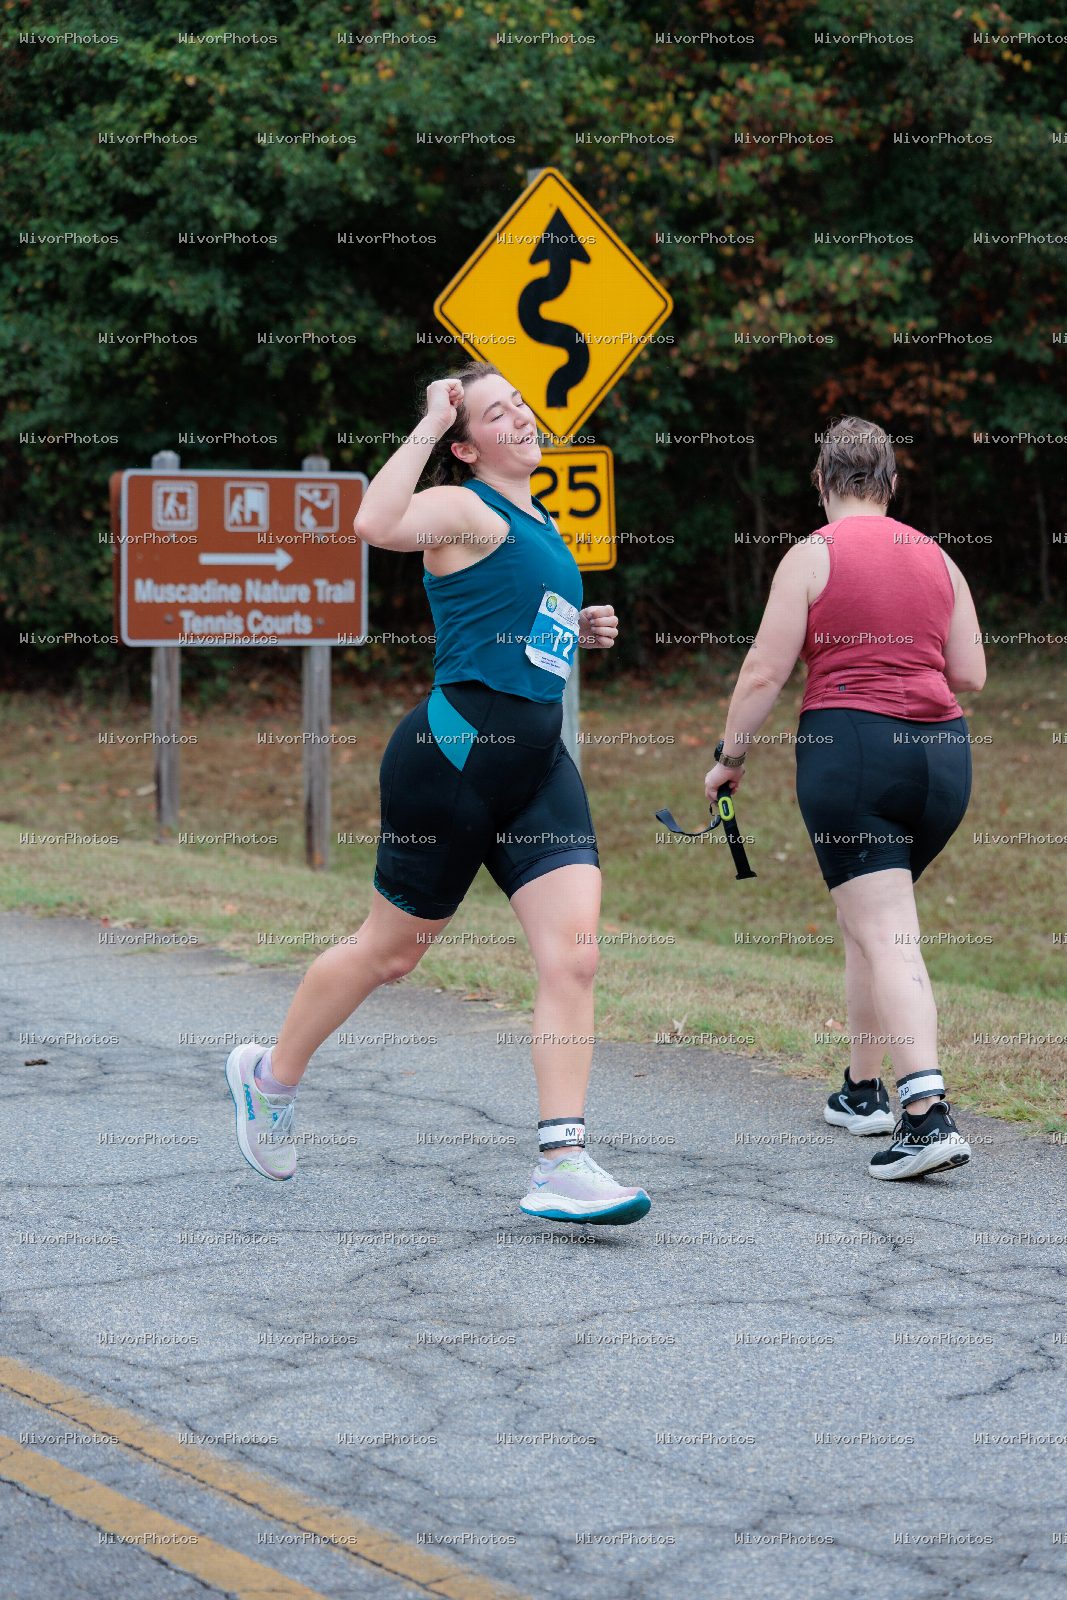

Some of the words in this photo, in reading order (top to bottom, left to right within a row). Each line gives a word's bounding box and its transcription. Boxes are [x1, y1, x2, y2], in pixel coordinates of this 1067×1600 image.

[530, 466, 601, 518] 25
[134, 578, 242, 604] Muscadine
[245, 578, 310, 604] Nature
[313, 578, 355, 604] Trail
[178, 609, 244, 635] Tennis
[247, 610, 312, 635] Courts
